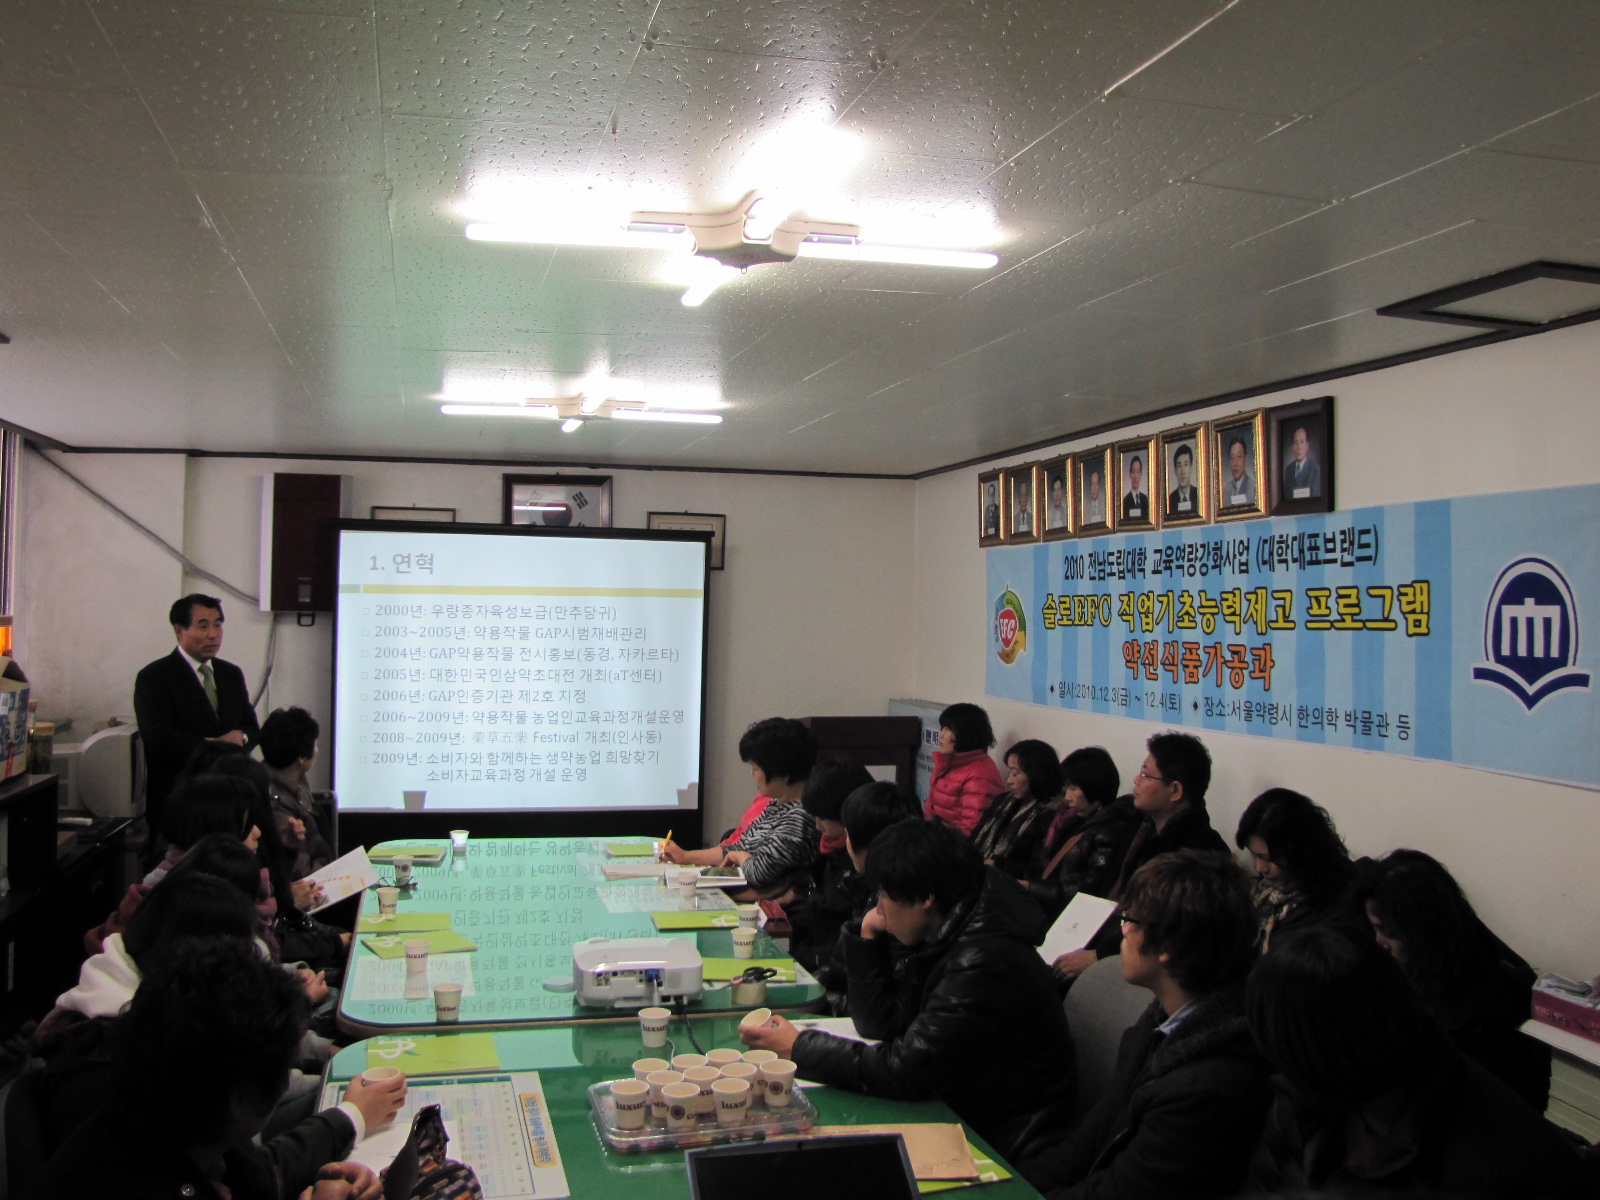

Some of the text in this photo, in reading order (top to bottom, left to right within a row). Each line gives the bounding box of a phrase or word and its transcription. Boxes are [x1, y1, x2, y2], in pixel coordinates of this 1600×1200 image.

[1064, 523, 1380, 581] 2010 전남도립대학 교육역량강화사업 (대학대표브랜드)
[369, 552, 436, 575] 1. 연혁
[375, 604, 618, 622] 2000년: 우량종자육성보급(만추당귀)
[1042, 592, 1112, 630] 슬로EFC
[1118, 587, 1297, 637] 직업기초능력제고
[1304, 580, 1432, 638] 프로그램
[374, 626, 647, 642] 2003~2005년: 약용작물 GAP시범재배관리
[1000, 618, 1016, 640] EFC
[374, 647, 679, 662] 2004년: GAP약용작물 전시홍보(동경, 자카르타)
[1122, 638, 1276, 692] 약선식품가공과
[374, 668, 662, 684] 2005년: 대한민국인삼약초대전 개최(aT센터)
[373, 689, 586, 704] 2006년: GAP인증기관 제2호 지정
[373, 710, 684, 725] 2006~2009년: 약용작물 농업인교육과정개설운영
[1145, 692, 1182, 712] 12.4(토)
[1203, 694, 1292, 728] 장소:서울약령시
[1297, 705, 1340, 734] 한의학
[1344, 710, 1390, 738] 박물관
[1395, 714, 1412, 741] 등
[372, 732, 466, 746] 2008~2009년:
[533, 731, 579, 744] Festival
[584, 731, 662, 746] 개최(인사동)
[372, 751, 660, 766] 2009년: 소비자와 함께하는 생약농업 희망찾기
[426, 768, 588, 783] 소비자교육과정 개설 운영
